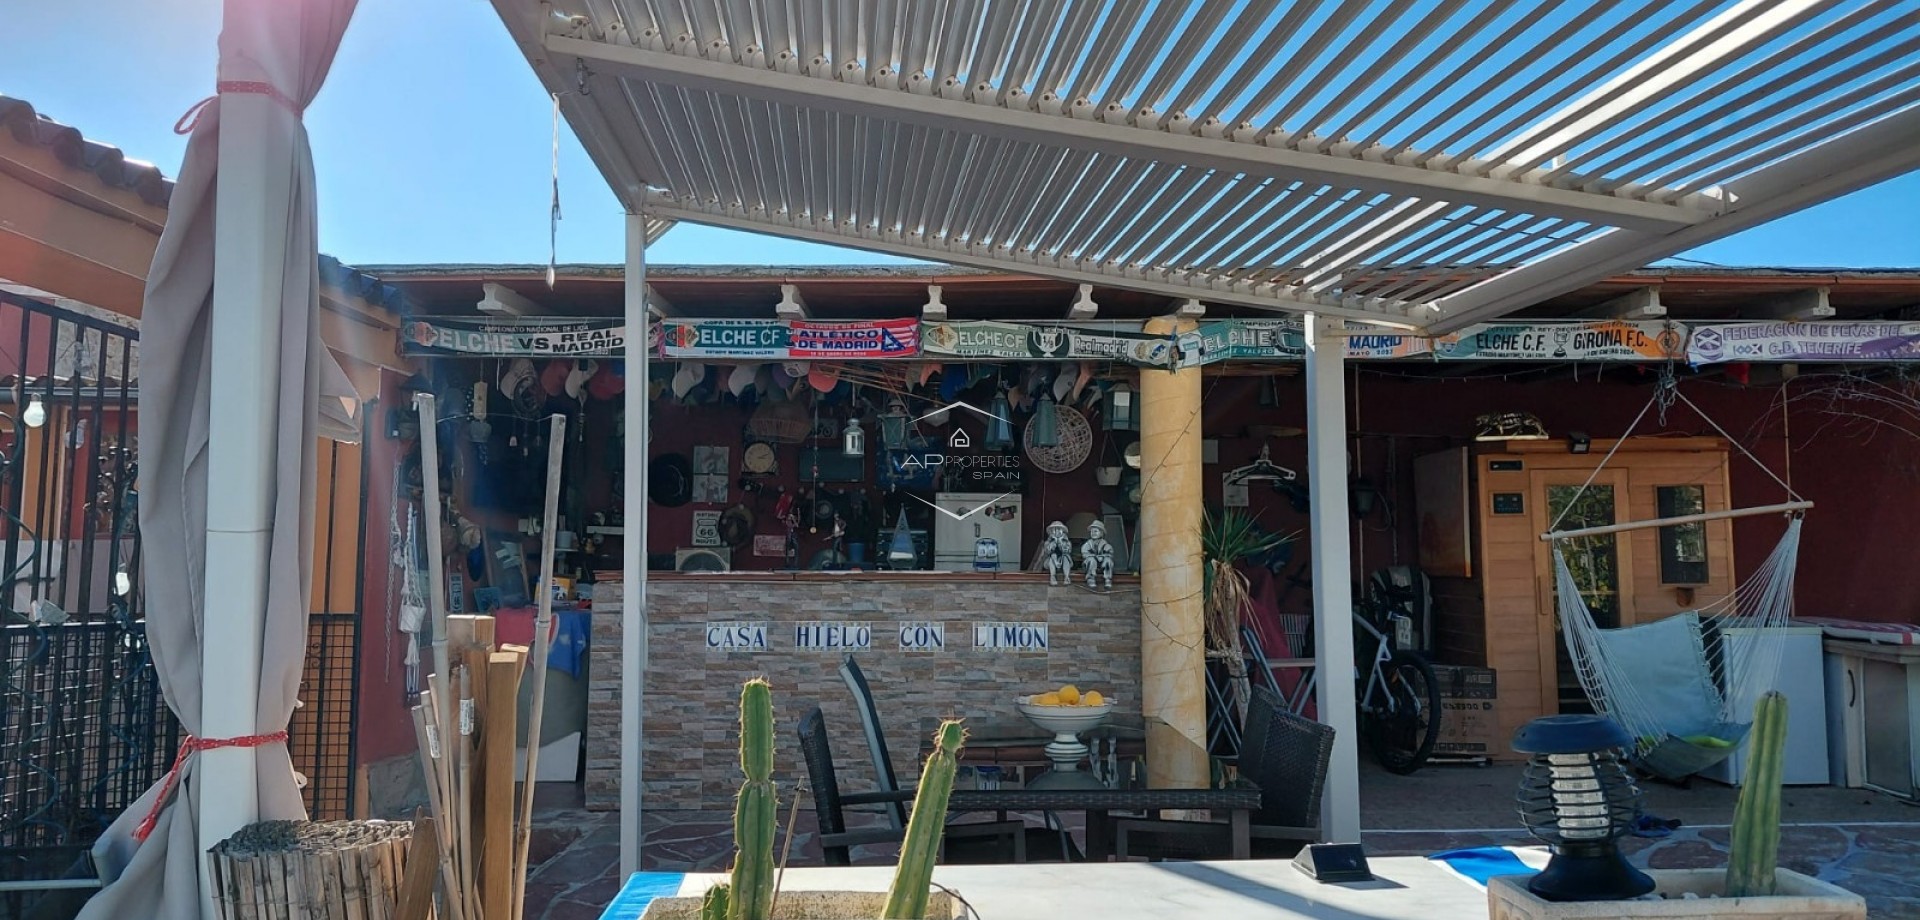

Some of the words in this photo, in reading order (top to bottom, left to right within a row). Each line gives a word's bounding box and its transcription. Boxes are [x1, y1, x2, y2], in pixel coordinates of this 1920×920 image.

[526, 325, 560, 333] NACIONAL
[561, 330, 617, 342] REAL
[701, 328, 757, 345] ELCHE
[760, 329, 780, 345] CF
[1810, 324, 1829, 337] DE
[439, 328, 515, 352] ELCHE
[517, 337, 549, 350] VS
[552, 337, 624, 353] MADRID
[798, 340, 817, 349] DE
[822, 340, 878, 349] MADRID
[959, 331, 1004, 347] ELCHE
[1004, 333, 1025, 348] CF
[1204, 328, 1272, 353] ELCHE
[1349, 335, 1403, 349] MADRID
[1476, 333, 1520, 351] ELCHE
[1522, 333, 1545, 351] C.F.
[1573, 329, 1622, 350] GIRONA
[1626, 330, 1648, 347] F.C.
[1798, 341, 1862, 354] TENERIFE
[700, 528, 714, 536] 66
[707, 627, 765, 647] CASA
[797, 627, 870, 647] HIELO
[900, 626, 943, 647] CON
[974, 626, 1047, 647] LIMON
